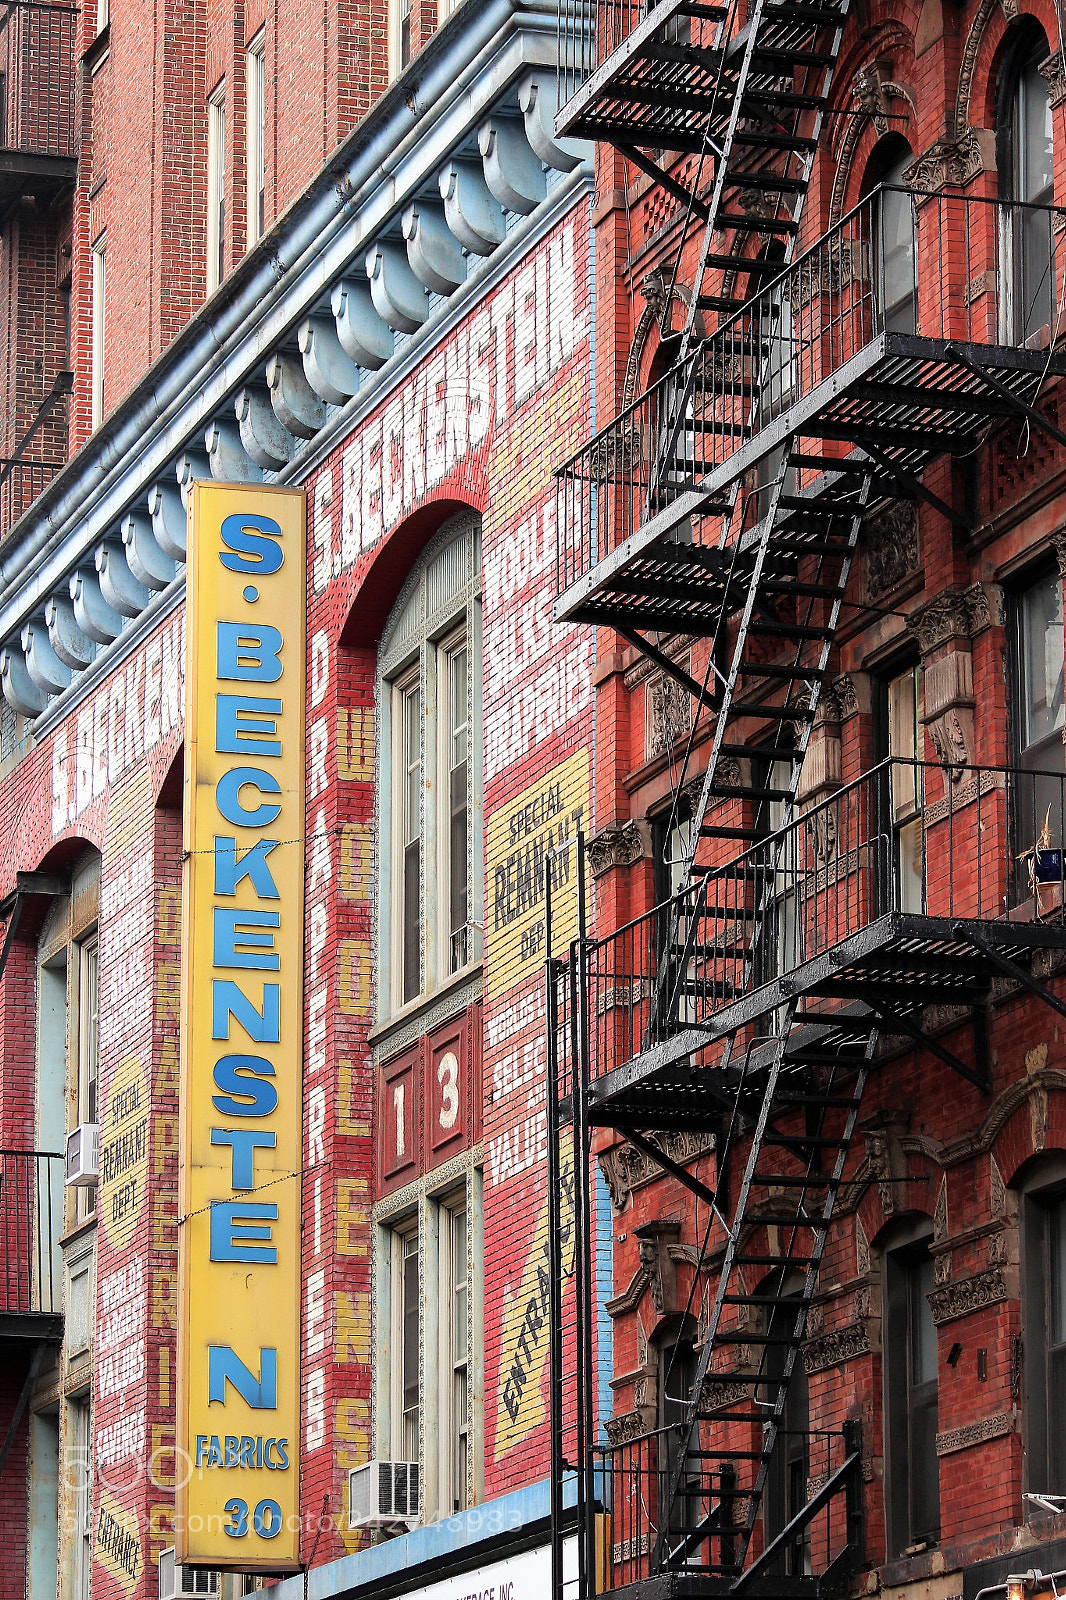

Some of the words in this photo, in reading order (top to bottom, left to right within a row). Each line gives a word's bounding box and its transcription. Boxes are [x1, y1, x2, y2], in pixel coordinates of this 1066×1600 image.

[488, 585, 550, 697] SILKS
[485, 638, 590, 780] DRAPERIES
[508, 781, 565, 845] SPECIAL
[494, 805, 584, 932] REMNANT
[306, 627, 333, 1455] DRAPERIES
[112, 1079, 140, 1126] SPECIAL
[335, 707, 374, 1468] WOOLENS
[526, 1080, 547, 1110] AN
[103, 1118, 148, 1186] REMNANT
[98, 1292, 144, 1351] LARGEST
[99, 1339, 144, 1400] VALUES
[97, 1409, 145, 1466] SAVINGS
[195, 1435, 289, 1470] FABRICS
[97, 1507, 140, 1580] ENTRANCE
[223, 1497, 282, 1539] 30
